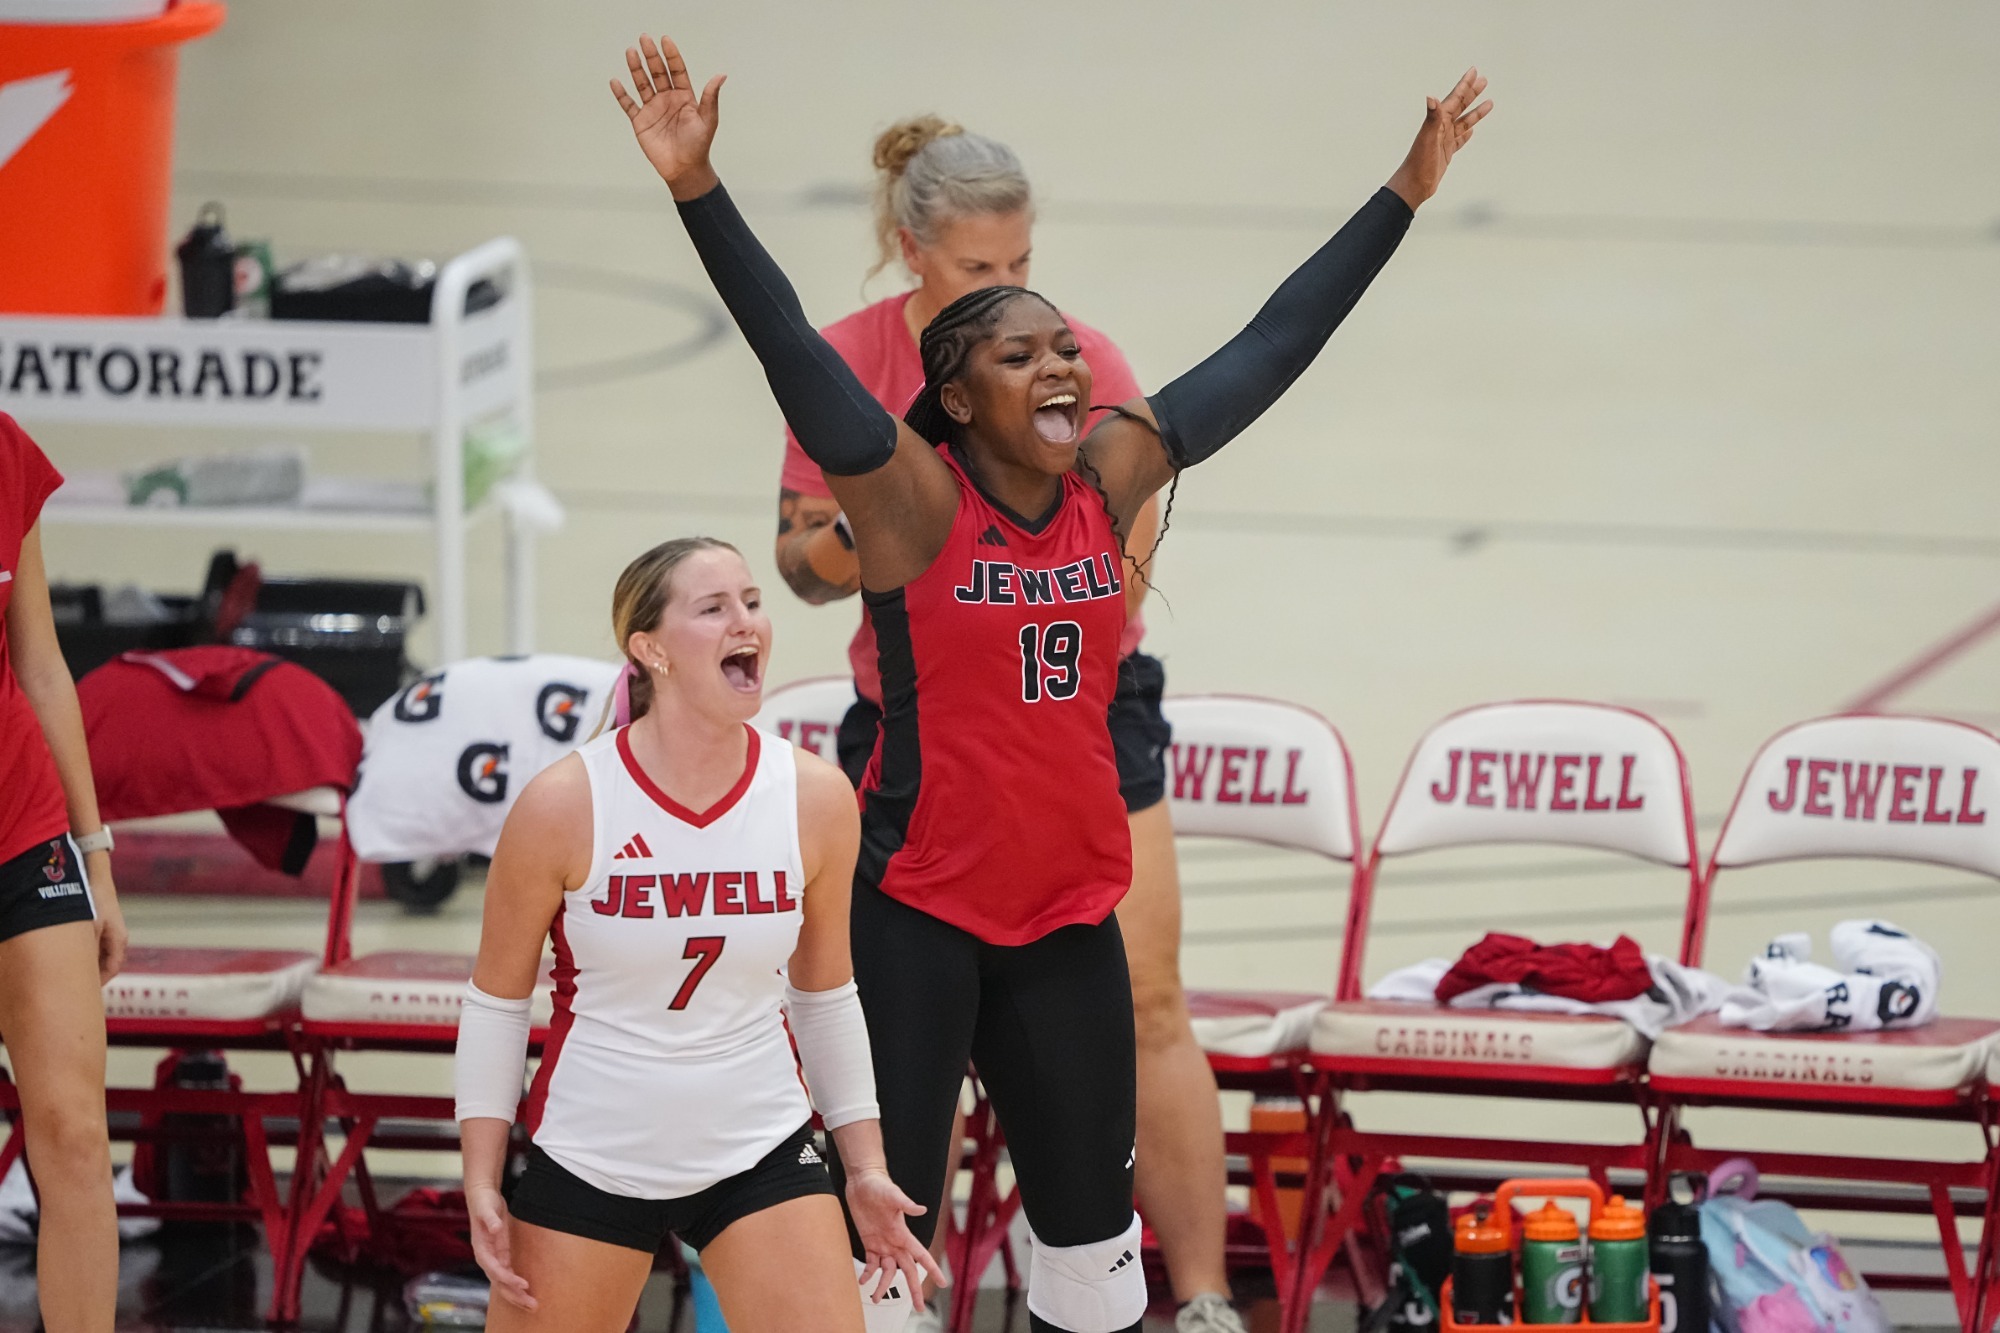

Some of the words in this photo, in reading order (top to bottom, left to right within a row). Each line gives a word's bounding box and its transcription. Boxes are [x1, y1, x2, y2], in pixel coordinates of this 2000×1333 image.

[0, 345, 321, 399] ATORADE
[954, 552, 1121, 605] JEWELL
[1018, 620, 1082, 703] 19
[394, 671, 446, 723] G
[536, 682, 588, 743] G
[457, 742, 509, 804] G
[1171, 743, 1309, 805] WELL
[1431, 750, 1645, 811] JEWELL
[1767, 758, 1986, 825] JEWELL
[590, 870, 797, 919] JEWELL
[666, 936, 726, 1010] 7
[1375, 1027, 1534, 1060] CARDINALS
